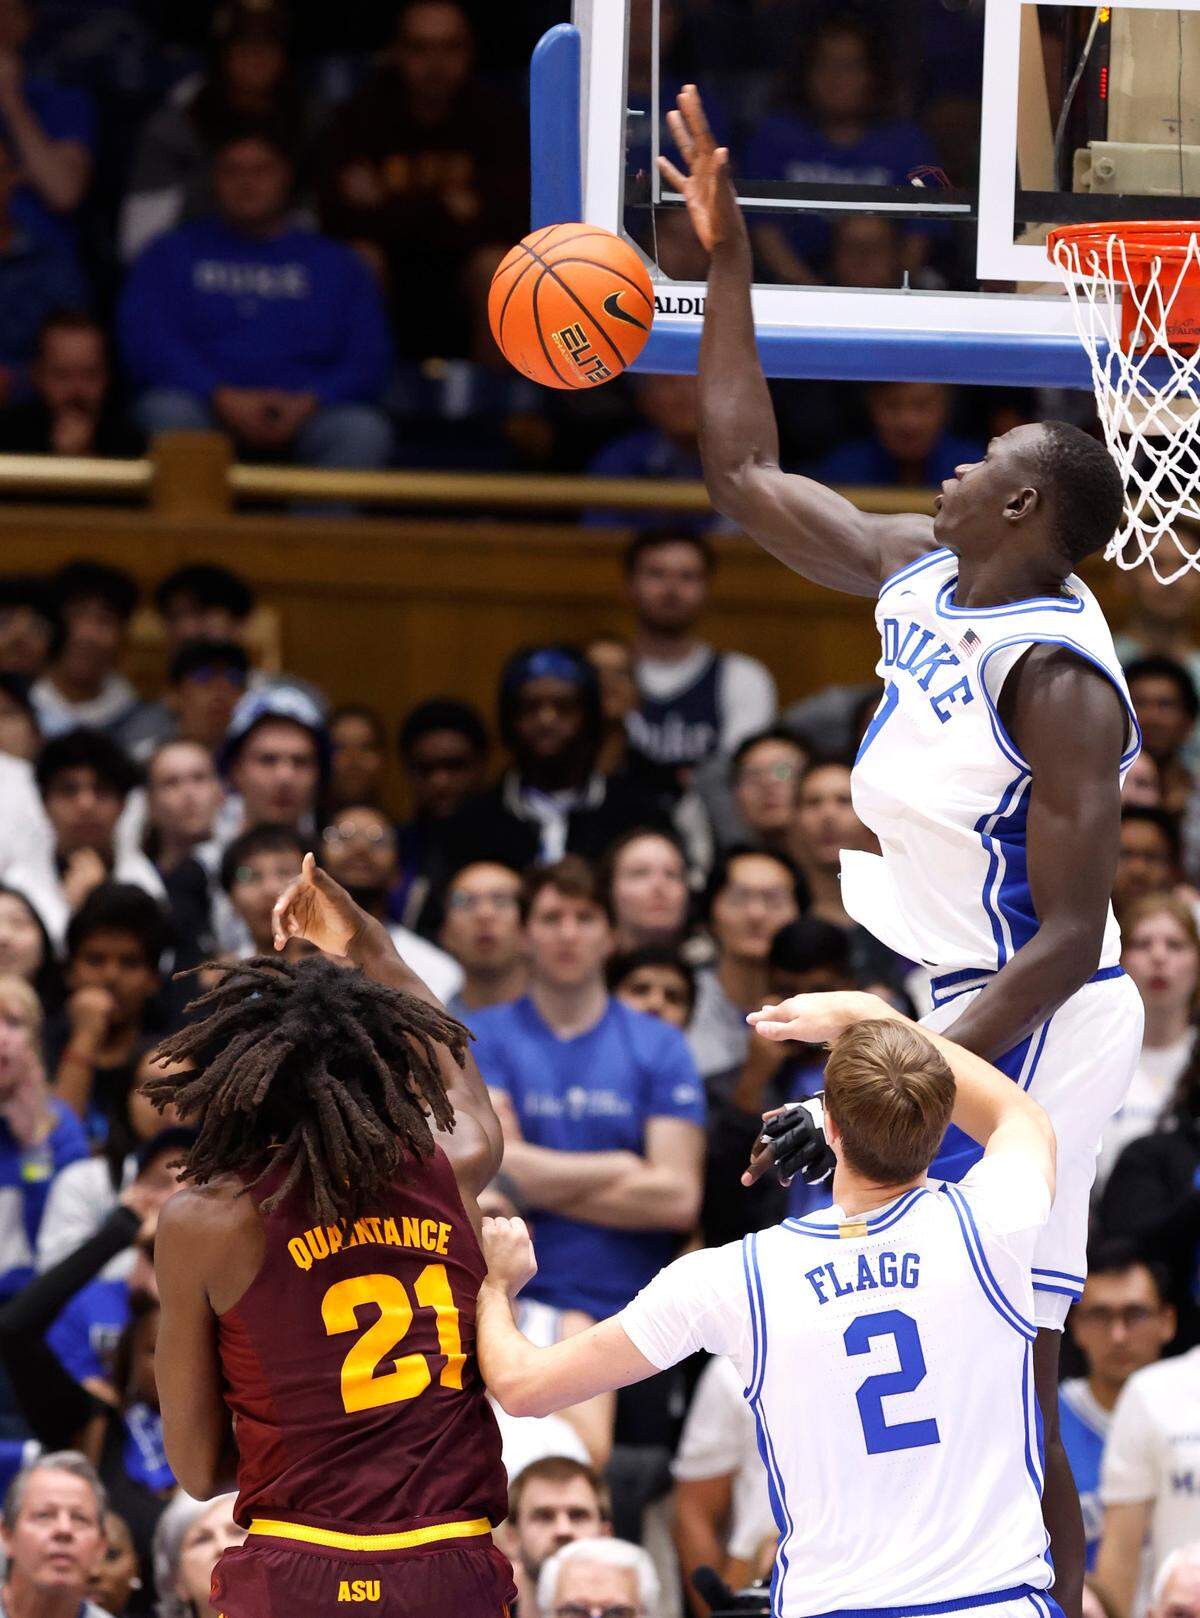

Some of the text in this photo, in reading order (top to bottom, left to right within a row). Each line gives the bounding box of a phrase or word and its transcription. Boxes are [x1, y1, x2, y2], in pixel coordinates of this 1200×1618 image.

[654, 296, 705, 316] ALDI
[558, 321, 612, 383] ELITE
[883, 618, 975, 725] DUKE
[804, 1251, 921, 1306] FLAGG
[320, 1263, 468, 1415] 21
[842, 1308, 941, 1455] 2
[337, 1580, 381, 1602] ASU
